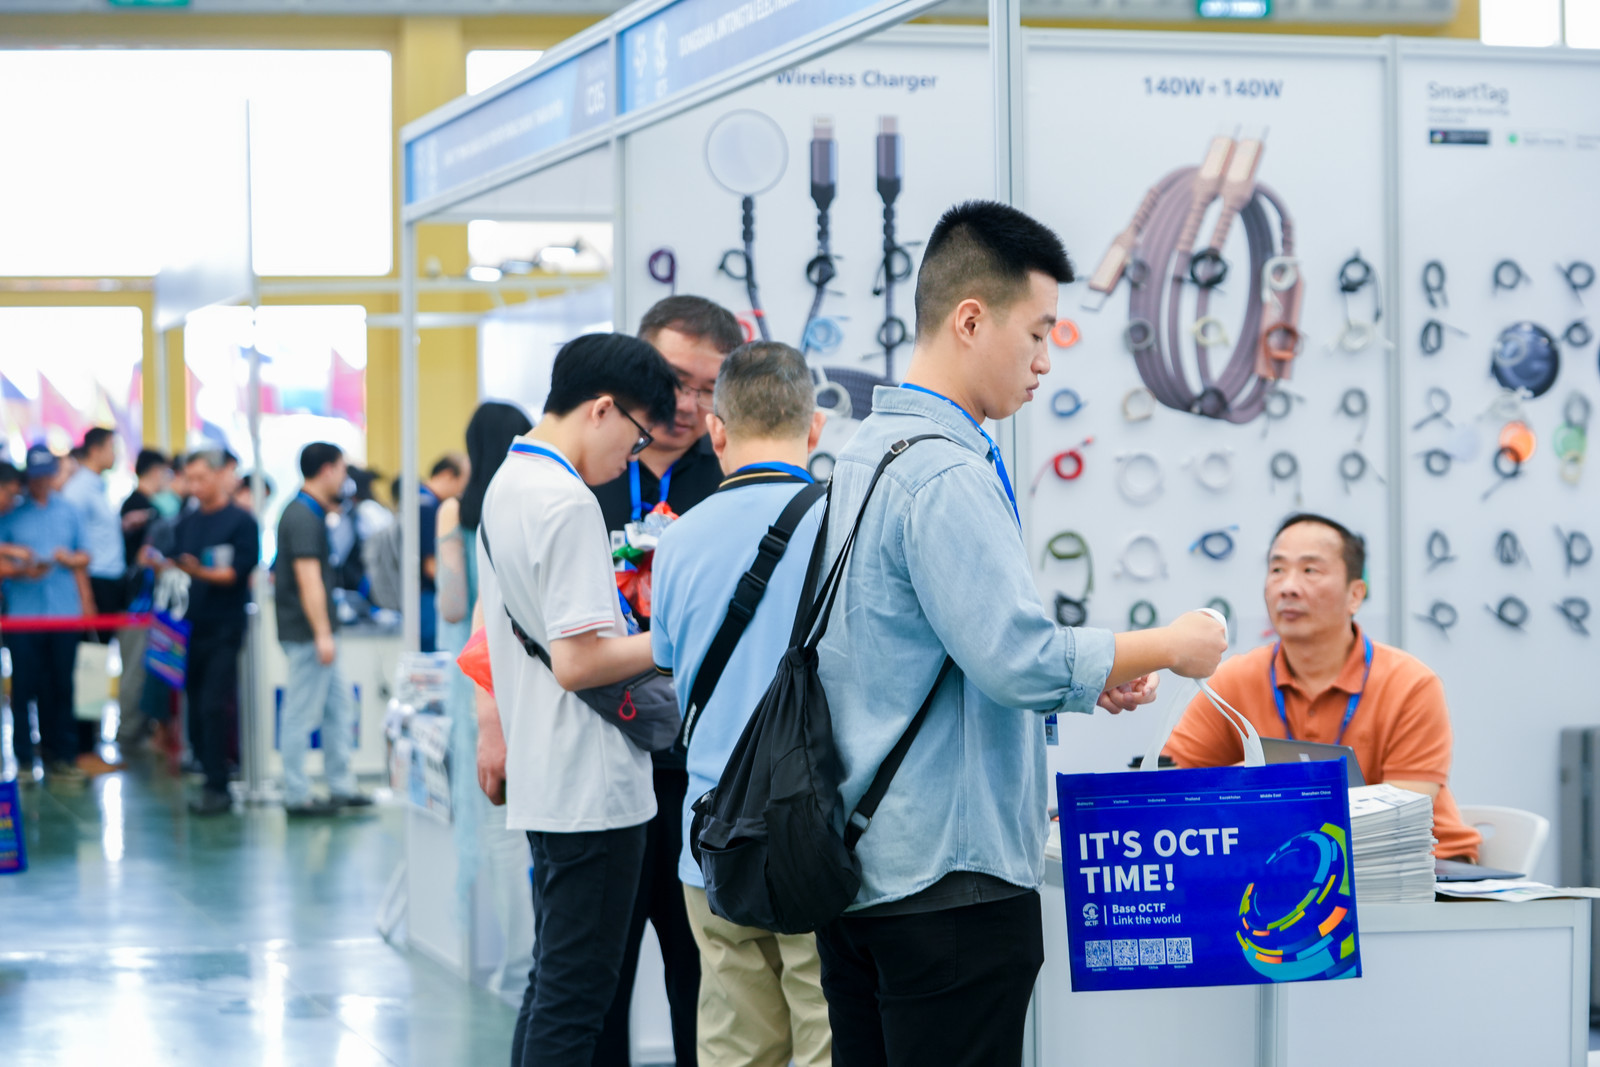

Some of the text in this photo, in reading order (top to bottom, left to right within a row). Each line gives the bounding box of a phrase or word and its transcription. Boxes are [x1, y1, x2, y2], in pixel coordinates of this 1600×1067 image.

[777, 68, 939, 93] Wireless Charger
[1144, 76, 1205, 96] 140W
[1222, 78, 1284, 97] 140W
[1426, 80, 1510, 105] SmartTag
[1079, 827, 1239, 860] IT'S OCTF
[1079, 863, 1175, 894] TIME!
[1112, 902, 1166, 914] Base OCTF
[1112, 913, 1182, 926] Link the world
